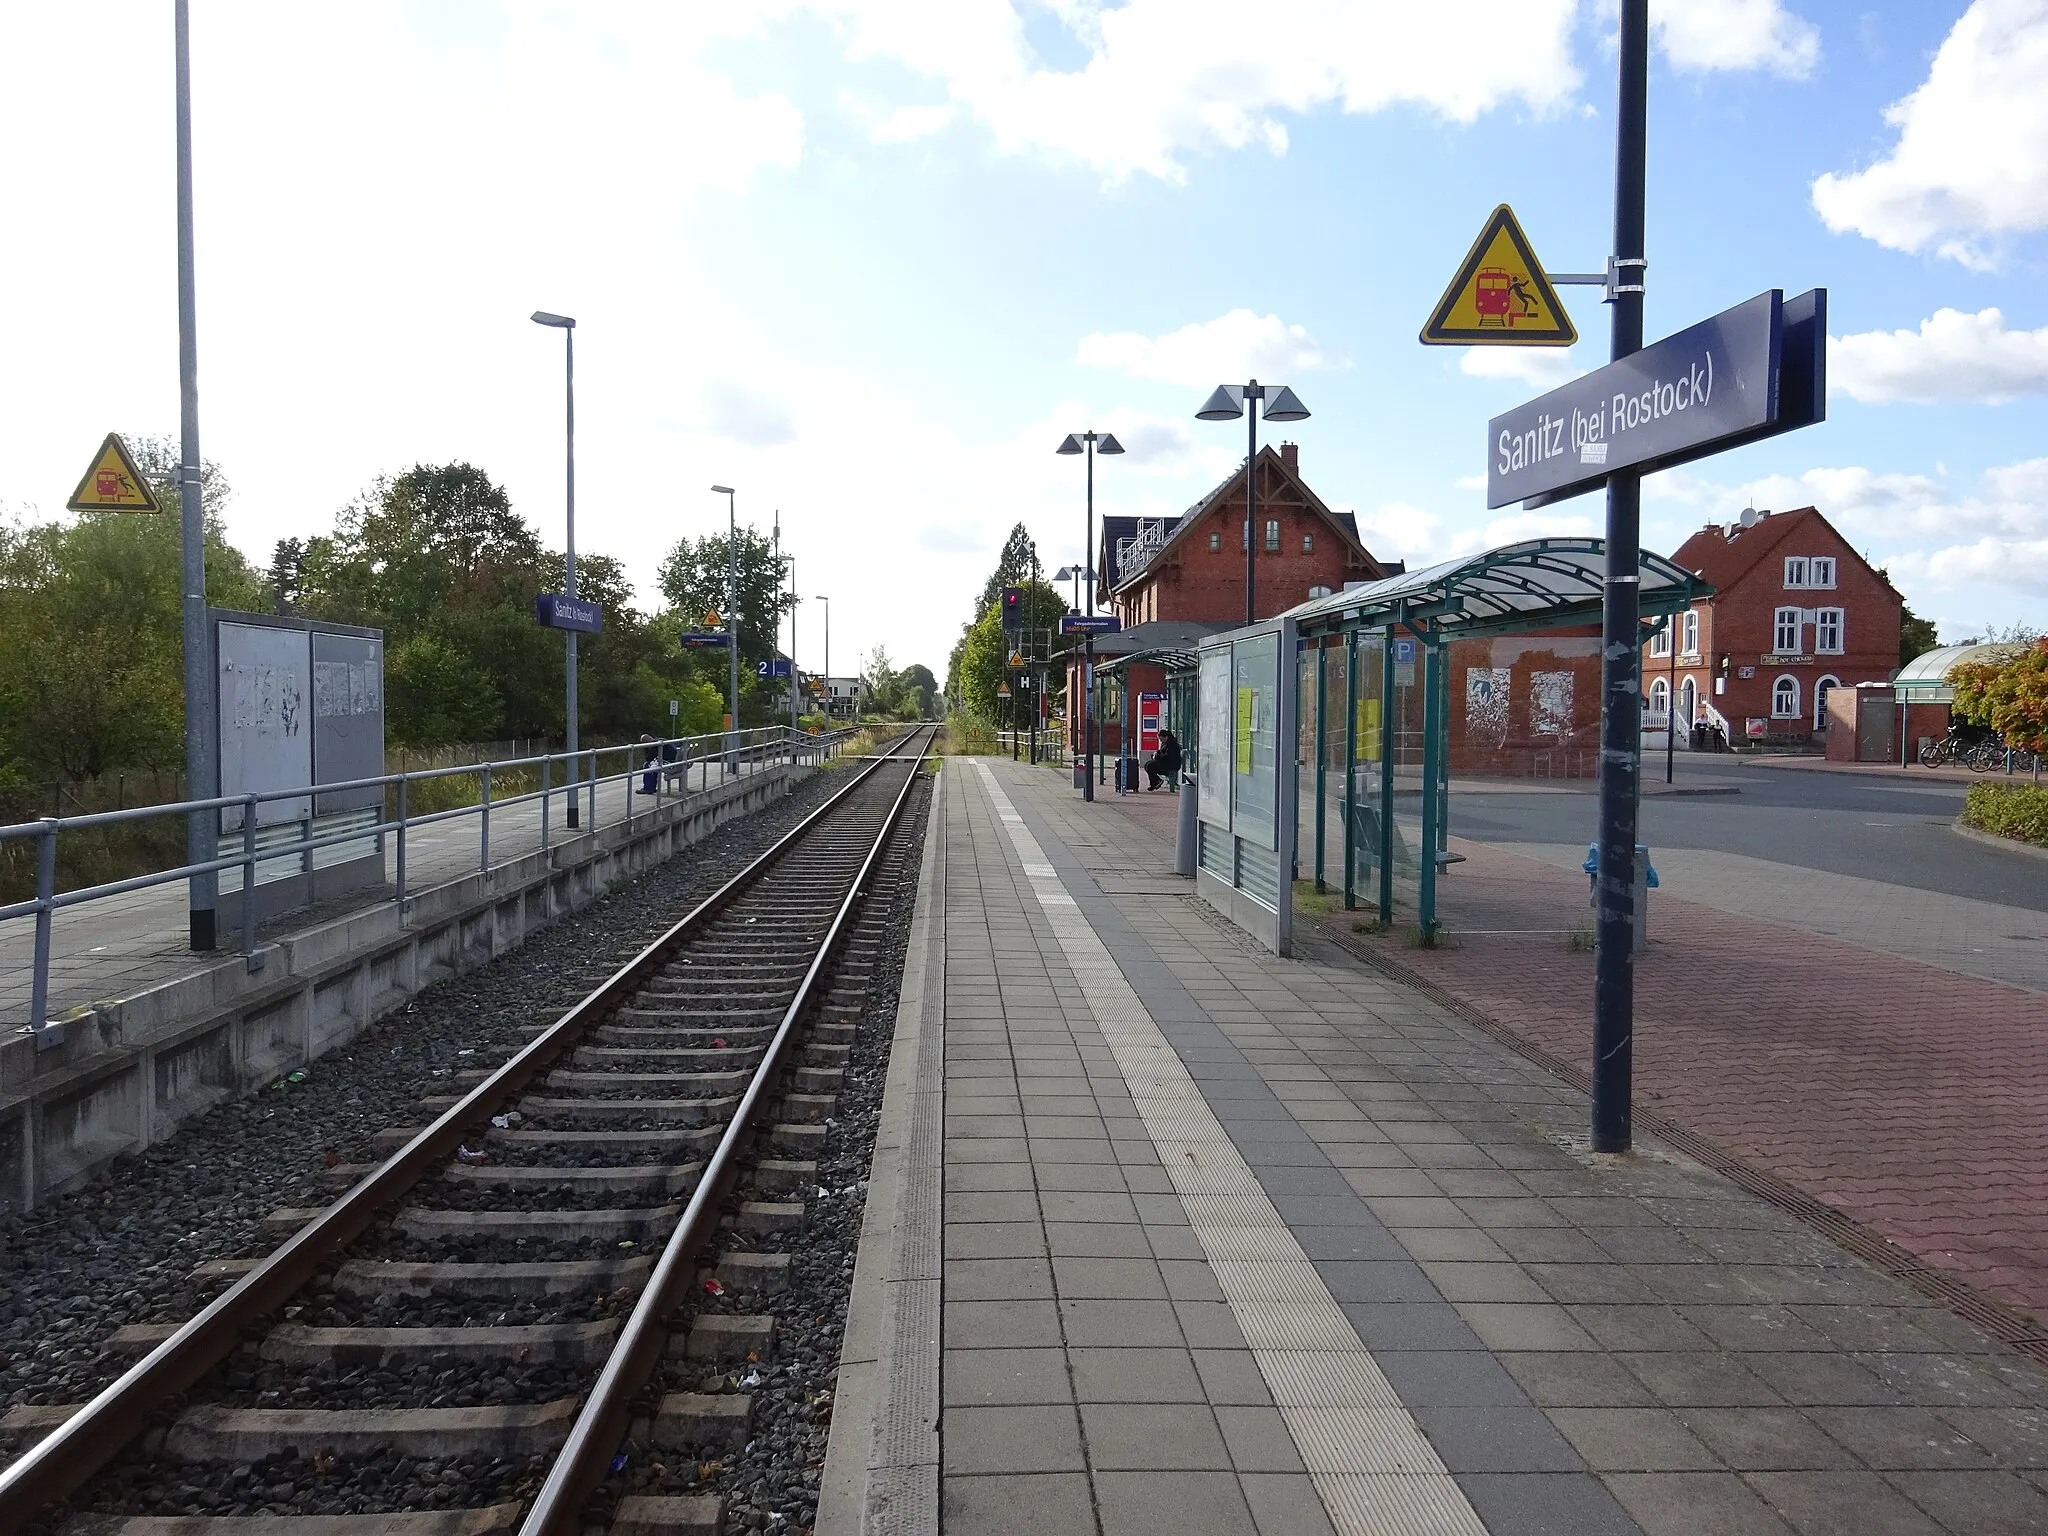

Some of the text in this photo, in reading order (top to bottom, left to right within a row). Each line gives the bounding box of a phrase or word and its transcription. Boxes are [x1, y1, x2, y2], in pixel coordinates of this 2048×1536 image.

[1498, 413, 1564, 476] Sanitz
[1571, 401, 1605, 453] (bei
[1612, 351, 1713, 435] Rostock)
[555, 600, 572, 619] Sanitz
[1398, 642, 1411, 660] P
[759, 661, 768, 674] 2
[1020, 676, 1030, 688] H
